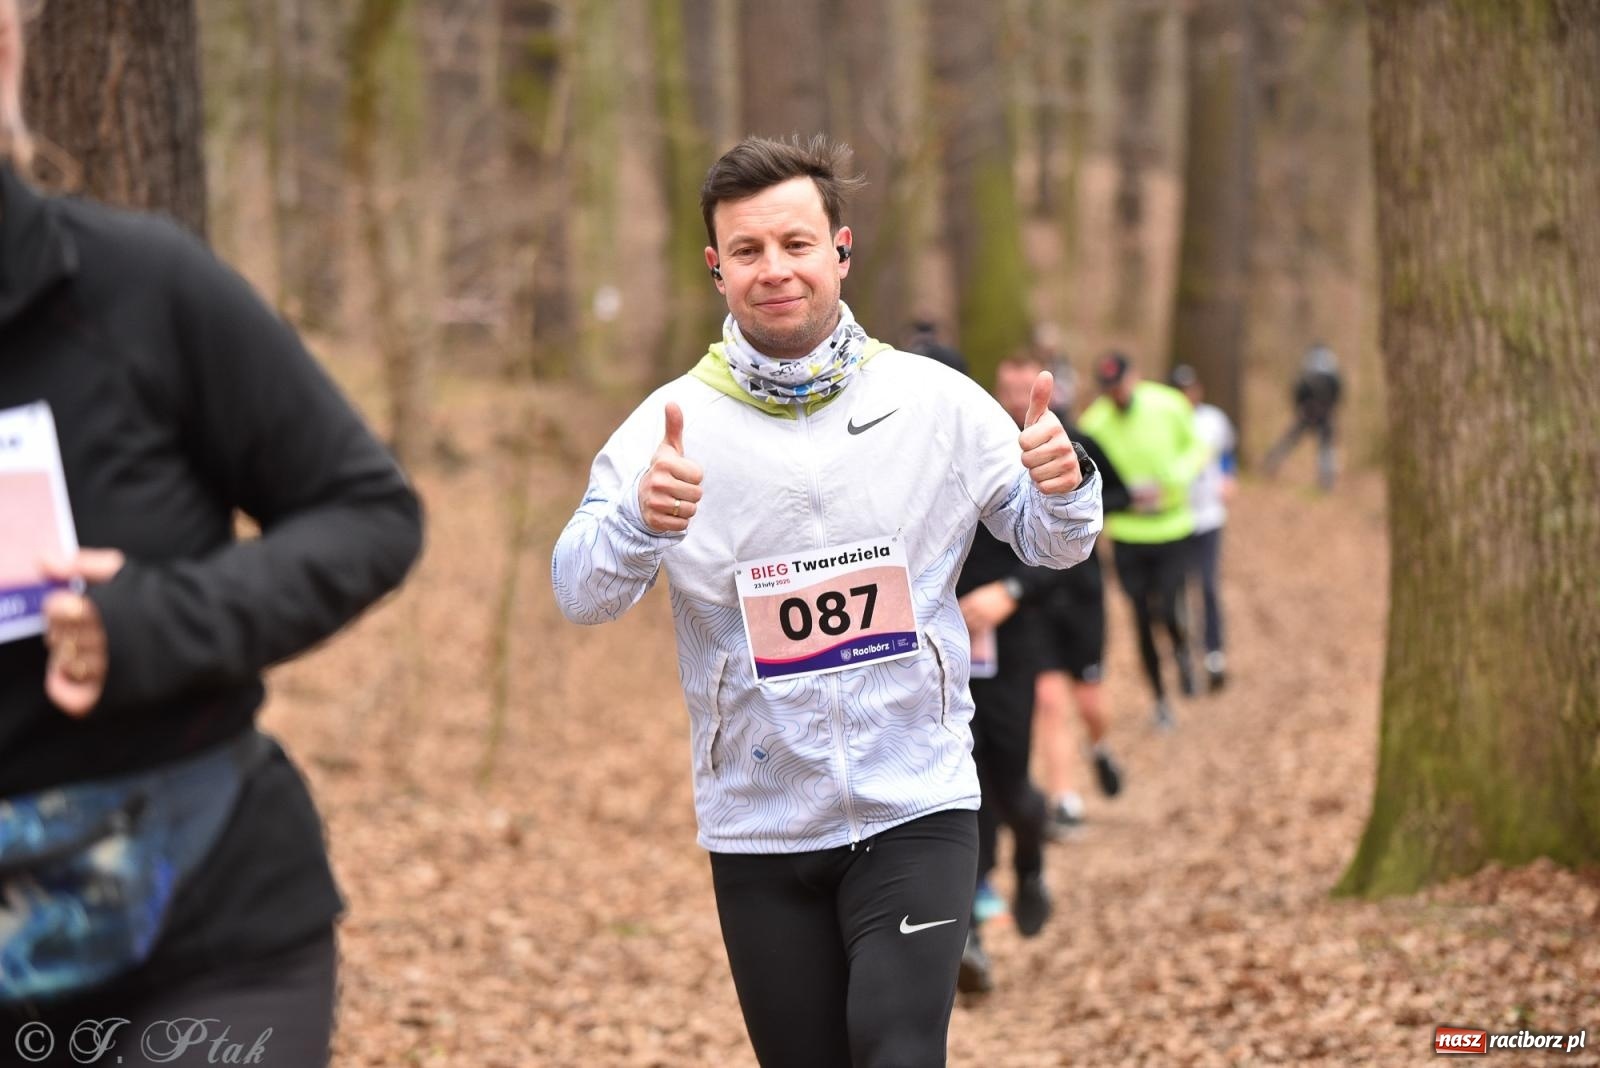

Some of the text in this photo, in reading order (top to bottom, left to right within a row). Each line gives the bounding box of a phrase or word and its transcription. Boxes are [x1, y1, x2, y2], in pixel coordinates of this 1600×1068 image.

[751, 546, 891, 580] BIEG Twardziela
[762, 581, 775, 589] luty
[779, 583, 877, 640] 087
